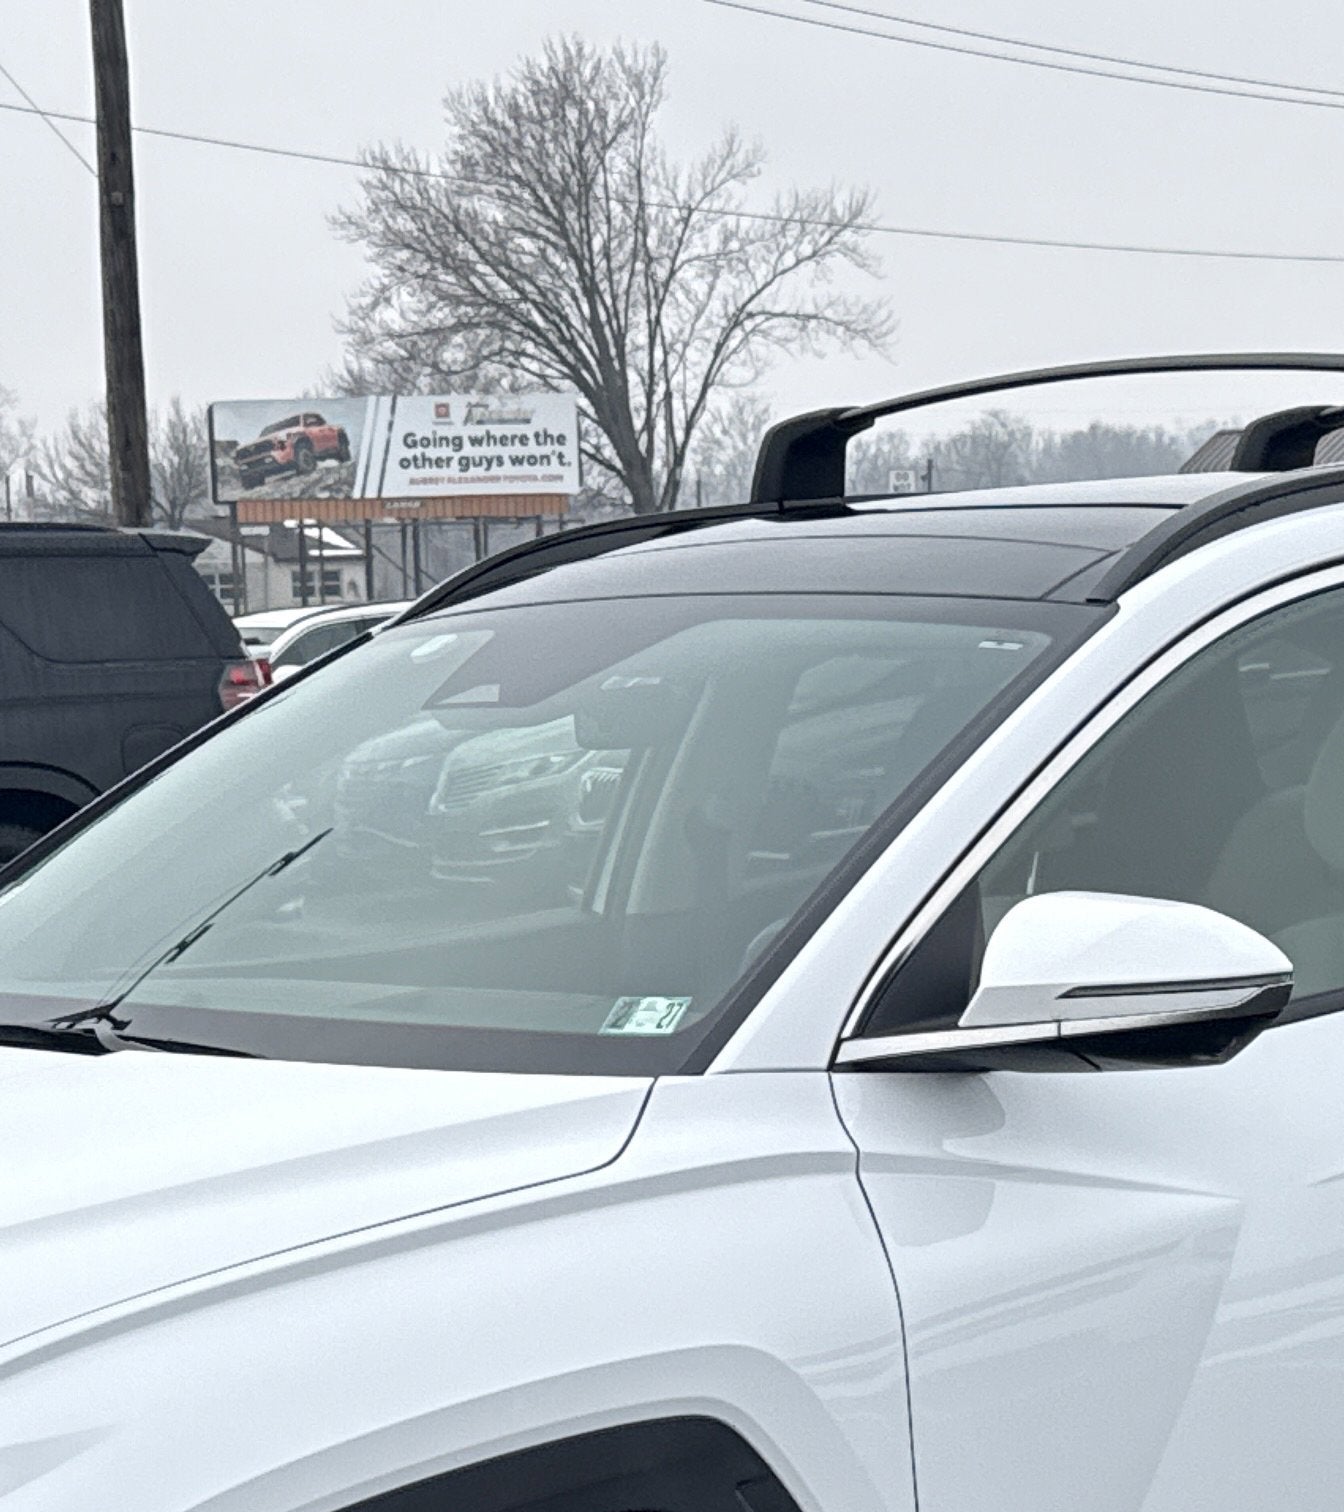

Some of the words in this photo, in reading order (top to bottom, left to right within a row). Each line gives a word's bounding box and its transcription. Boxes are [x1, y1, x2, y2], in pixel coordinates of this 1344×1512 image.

[403, 431, 464, 451] Going
[468, 430, 531, 448] where
[533, 428, 567, 446] the
[399, 452, 455, 470] other
[458, 454, 505, 473] guys
[508, 449, 572, 468] won't.
